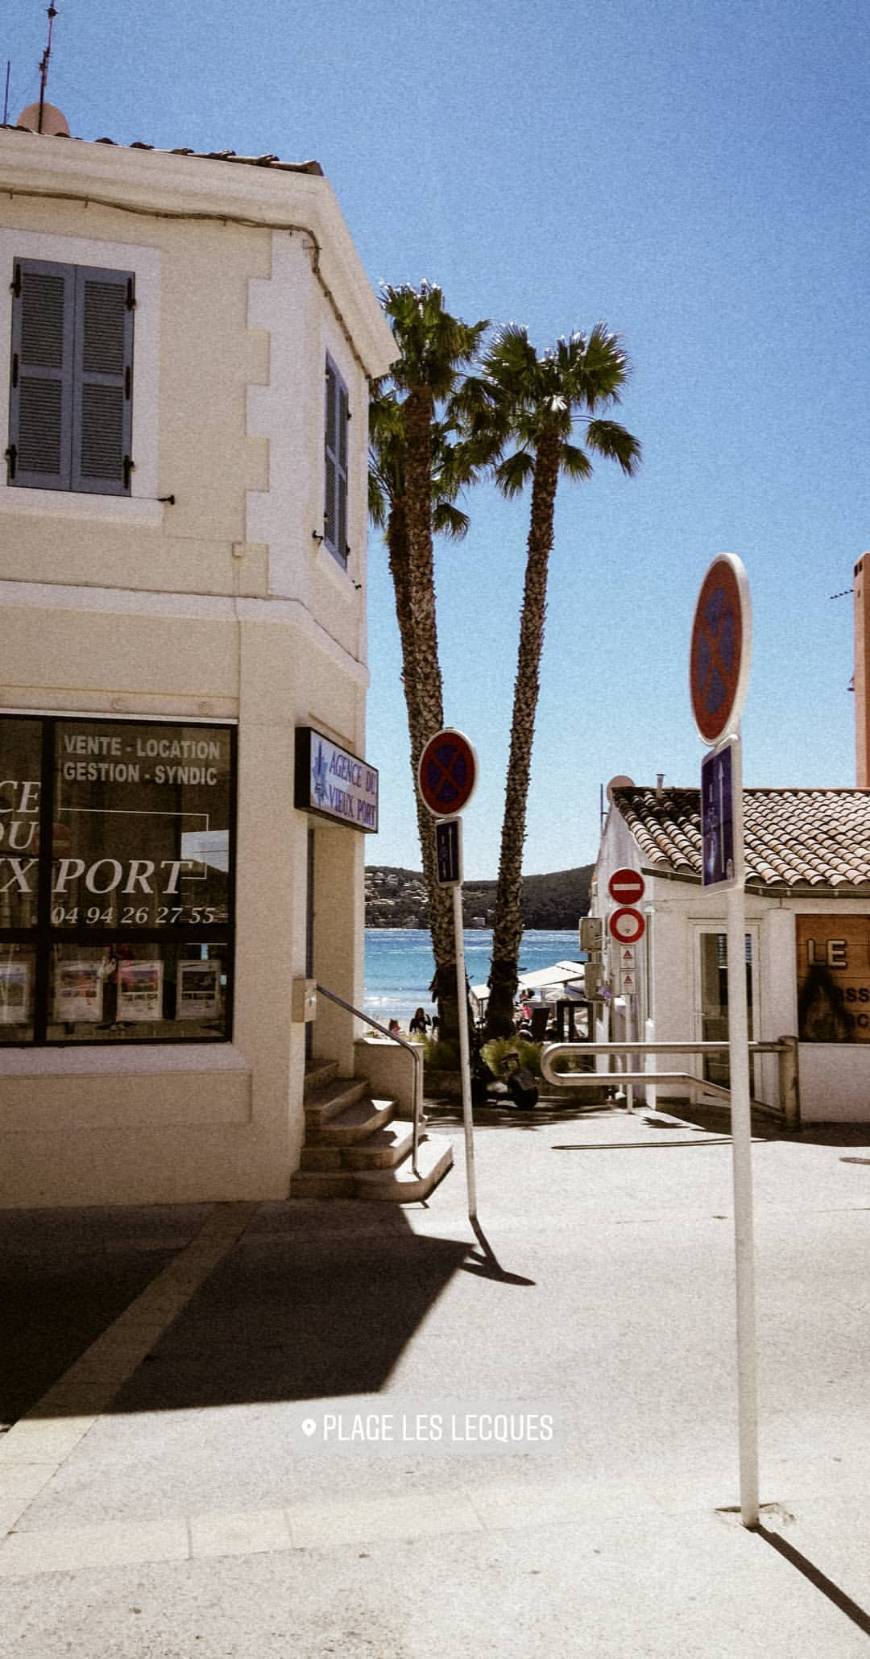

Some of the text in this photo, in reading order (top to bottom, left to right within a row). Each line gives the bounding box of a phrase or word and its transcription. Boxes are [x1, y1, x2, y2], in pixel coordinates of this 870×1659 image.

[64, 735, 122, 756] VENTE
[136, 738, 220, 760] LOCATION
[63, 761, 140, 783] GESTION
[155, 765, 218, 786] SYNDIC
[329, 751, 362, 788] AGENCE
[329, 783, 376, 826] VIEUX PORT
[0, 821, 40, 850] U
[51, 858, 194, 895] PORT
[51, 906, 216, 925] 04 94 26 27 55
[807, 938, 848, 969] LE
